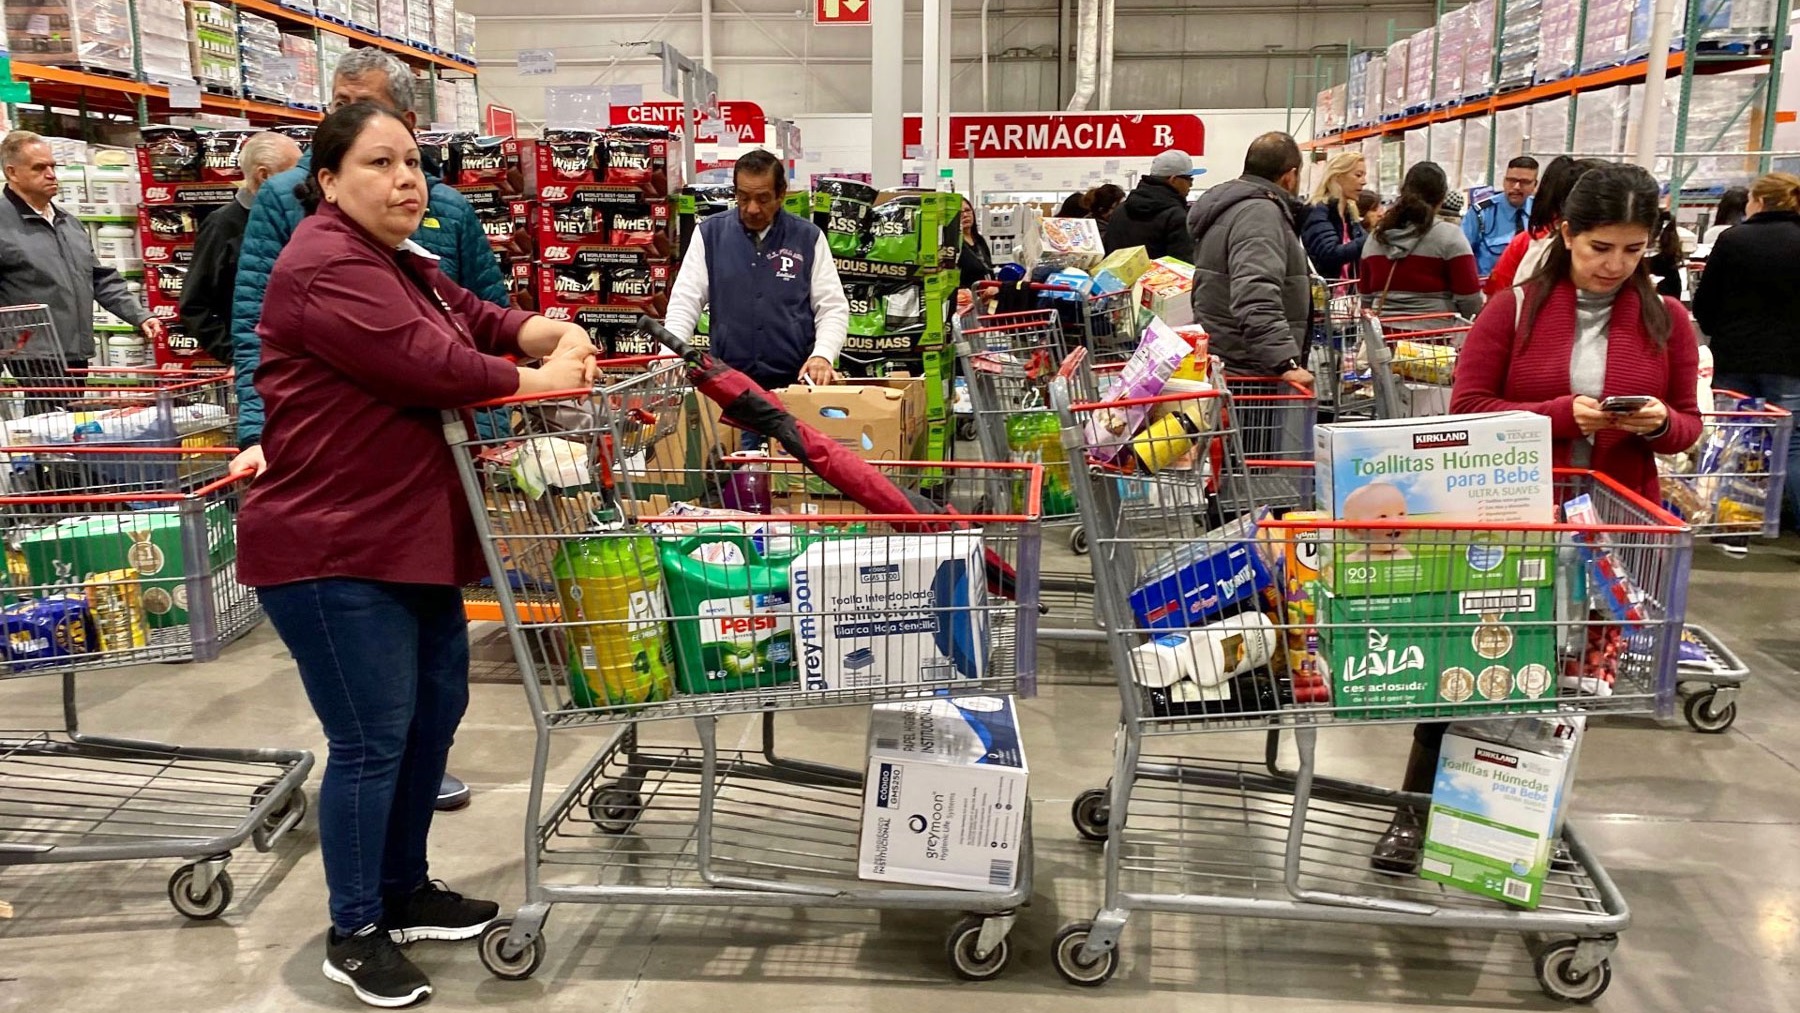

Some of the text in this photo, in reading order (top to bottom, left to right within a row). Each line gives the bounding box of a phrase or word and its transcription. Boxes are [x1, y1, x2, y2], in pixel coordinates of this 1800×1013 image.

[964, 123, 1126, 151] FARMACIA
[505, 143, 516, 151] 90
[653, 144, 664, 152] 90
[466, 157, 502, 169] WHEY
[612, 157, 651, 169] WHEY
[513, 204, 524, 212] 90
[654, 206, 666, 214] 90
[617, 219, 653, 231] WHEY
[828, 217, 856, 232] ASS
[780, 256, 794, 272] P
[833, 258, 907, 276] RIOUS MASS
[158, 278, 183, 289] WHE
[615, 281, 651, 294] WHEY
[619, 342, 653, 353] WHEY
[876, 336, 911, 348] MASS
[1416, 432, 1467, 444] KIRKLAND
[1351, 447, 1539, 476] Toallitas Húmedas
[1446, 467, 1540, 492] para Bebé
[1468, 485, 1541, 499] ULTRA SUAVES
[832, 590, 934, 605] Toalla Intedoblada
[720, 610, 777, 635] Persil
[874, 623, 897, 634] Hoa
[795, 570, 828, 691] greymoon
[1343, 646, 1425, 682] LALA
[1477, 749, 1517, 764] KIRKLAND
[1441, 757, 1488, 777] Toallitas
[1492, 769, 1550, 792] Húmedas
[880, 770, 890, 801] CÓDIGO
[890, 769, 901, 804] GMS250
[1492, 781, 1548, 802] para Bebé
[926, 793, 945, 859] greymoon
